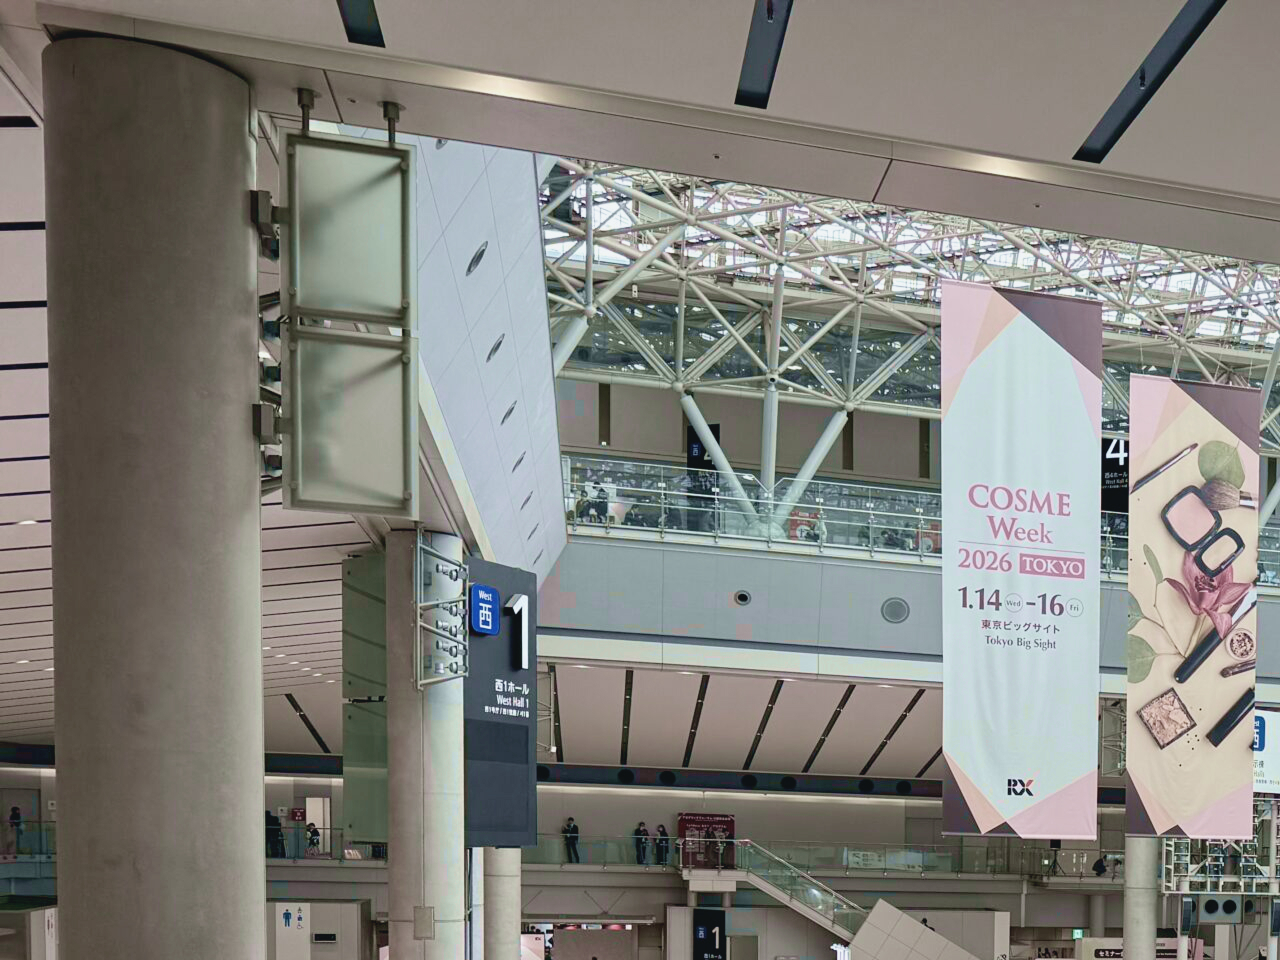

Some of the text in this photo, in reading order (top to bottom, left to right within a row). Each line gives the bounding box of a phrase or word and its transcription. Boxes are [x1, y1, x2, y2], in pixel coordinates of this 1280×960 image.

[1106, 439, 1128, 465] 4
[968, 484, 1071, 516] COSME
[987, 516, 1053, 544] Week
[958, 549, 1083, 575] 2026 TOKYO
[478, 590, 492, 601] West
[958, 586, 1002, 611] 1.14
[1070, 604, 1079, 612] Fri
[479, 603, 492, 629] 西
[981, 619, 1060, 634] 東京ビッグサイト
[513, 594, 529, 669] 1
[985, 635, 1056, 650] Tokyo Big Sight
[495, 679, 529, 695] 西1ホール
[496, 694, 529, 708] West Hall 1
[1008, 779, 1034, 796] RX
[712, 926, 720, 949] 1
